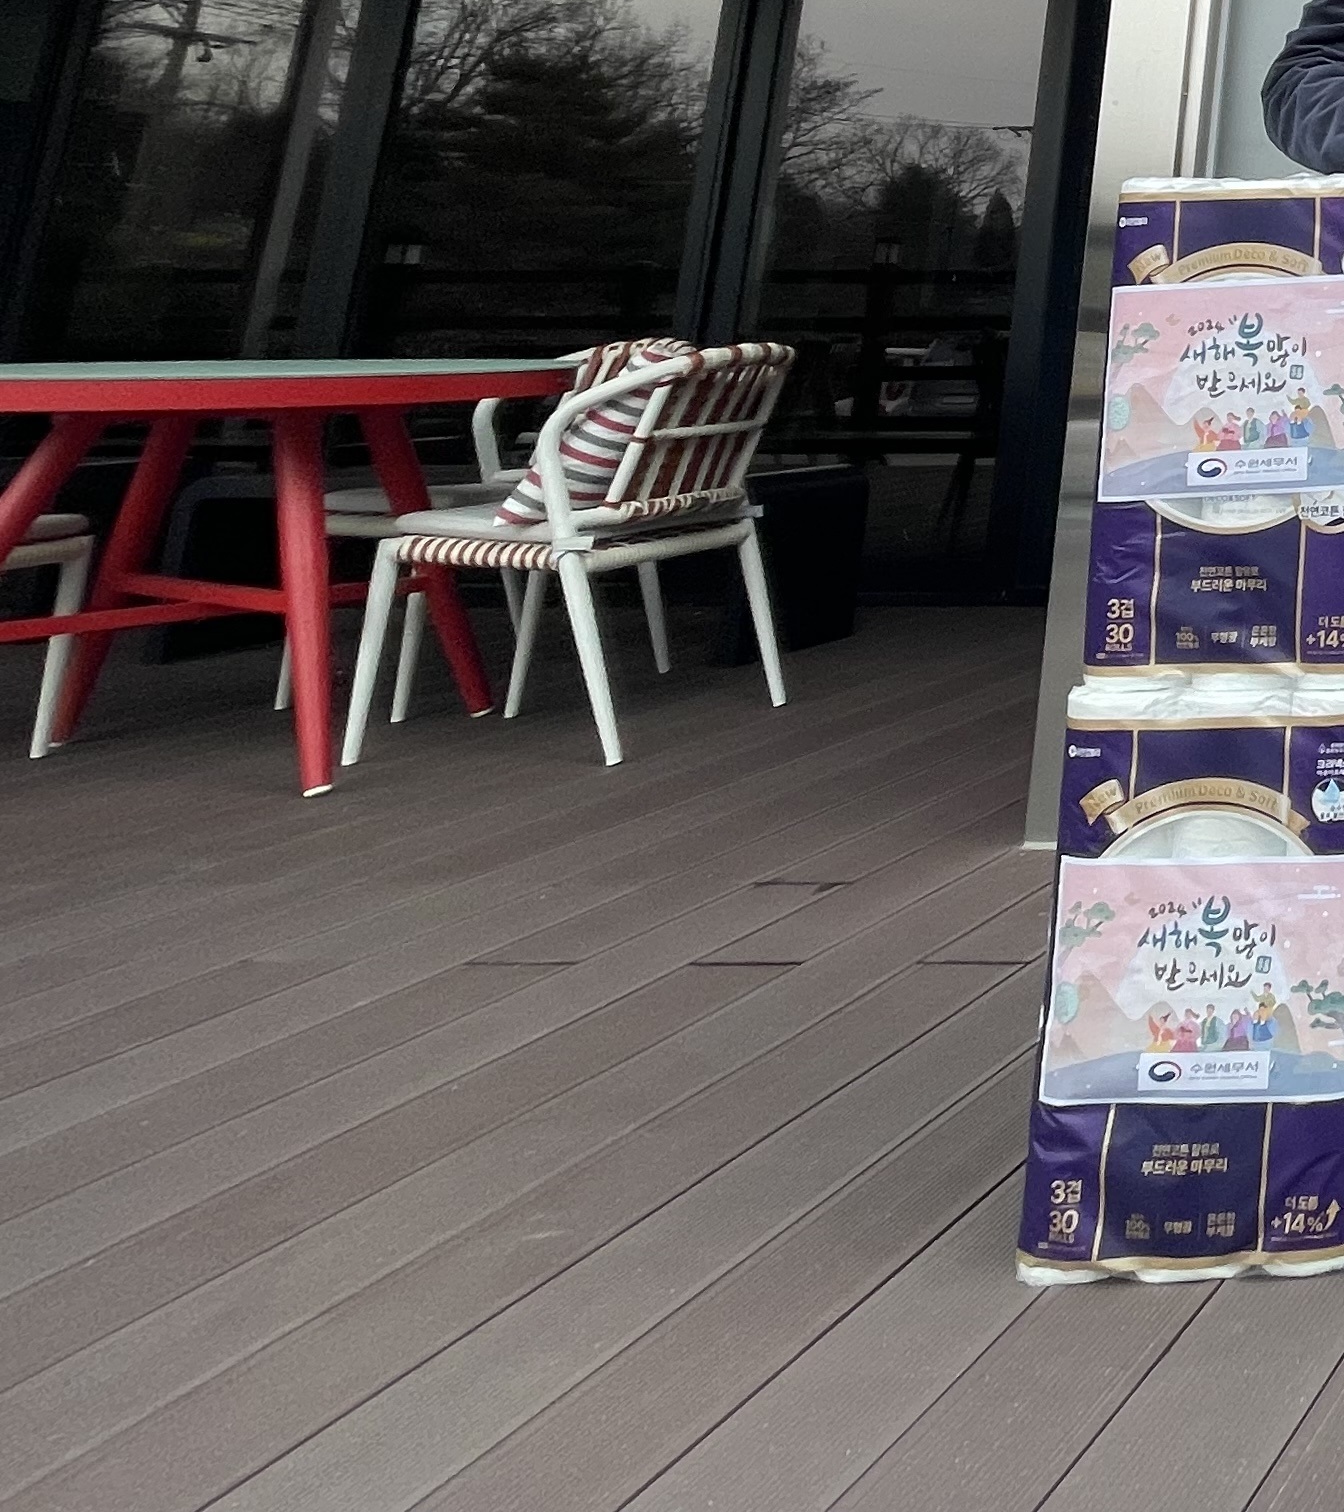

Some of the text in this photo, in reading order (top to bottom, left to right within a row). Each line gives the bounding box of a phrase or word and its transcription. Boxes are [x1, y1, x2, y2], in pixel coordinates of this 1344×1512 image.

[1180, 312, 1307, 367] 새해 복 많이
[1196, 368, 1287, 398] 받으세요
[1106, 598, 1135, 619] 3겹
[1105, 623, 1134, 643] 30
[1137, 895, 1276, 958] 새해 복 많이
[1154, 957, 1252, 991] 받으세요
[1050, 1179, 1083, 1204] 3겹
[1049, 1209, 1079, 1234] 30
[1271, 1211, 1323, 1234] +14%
